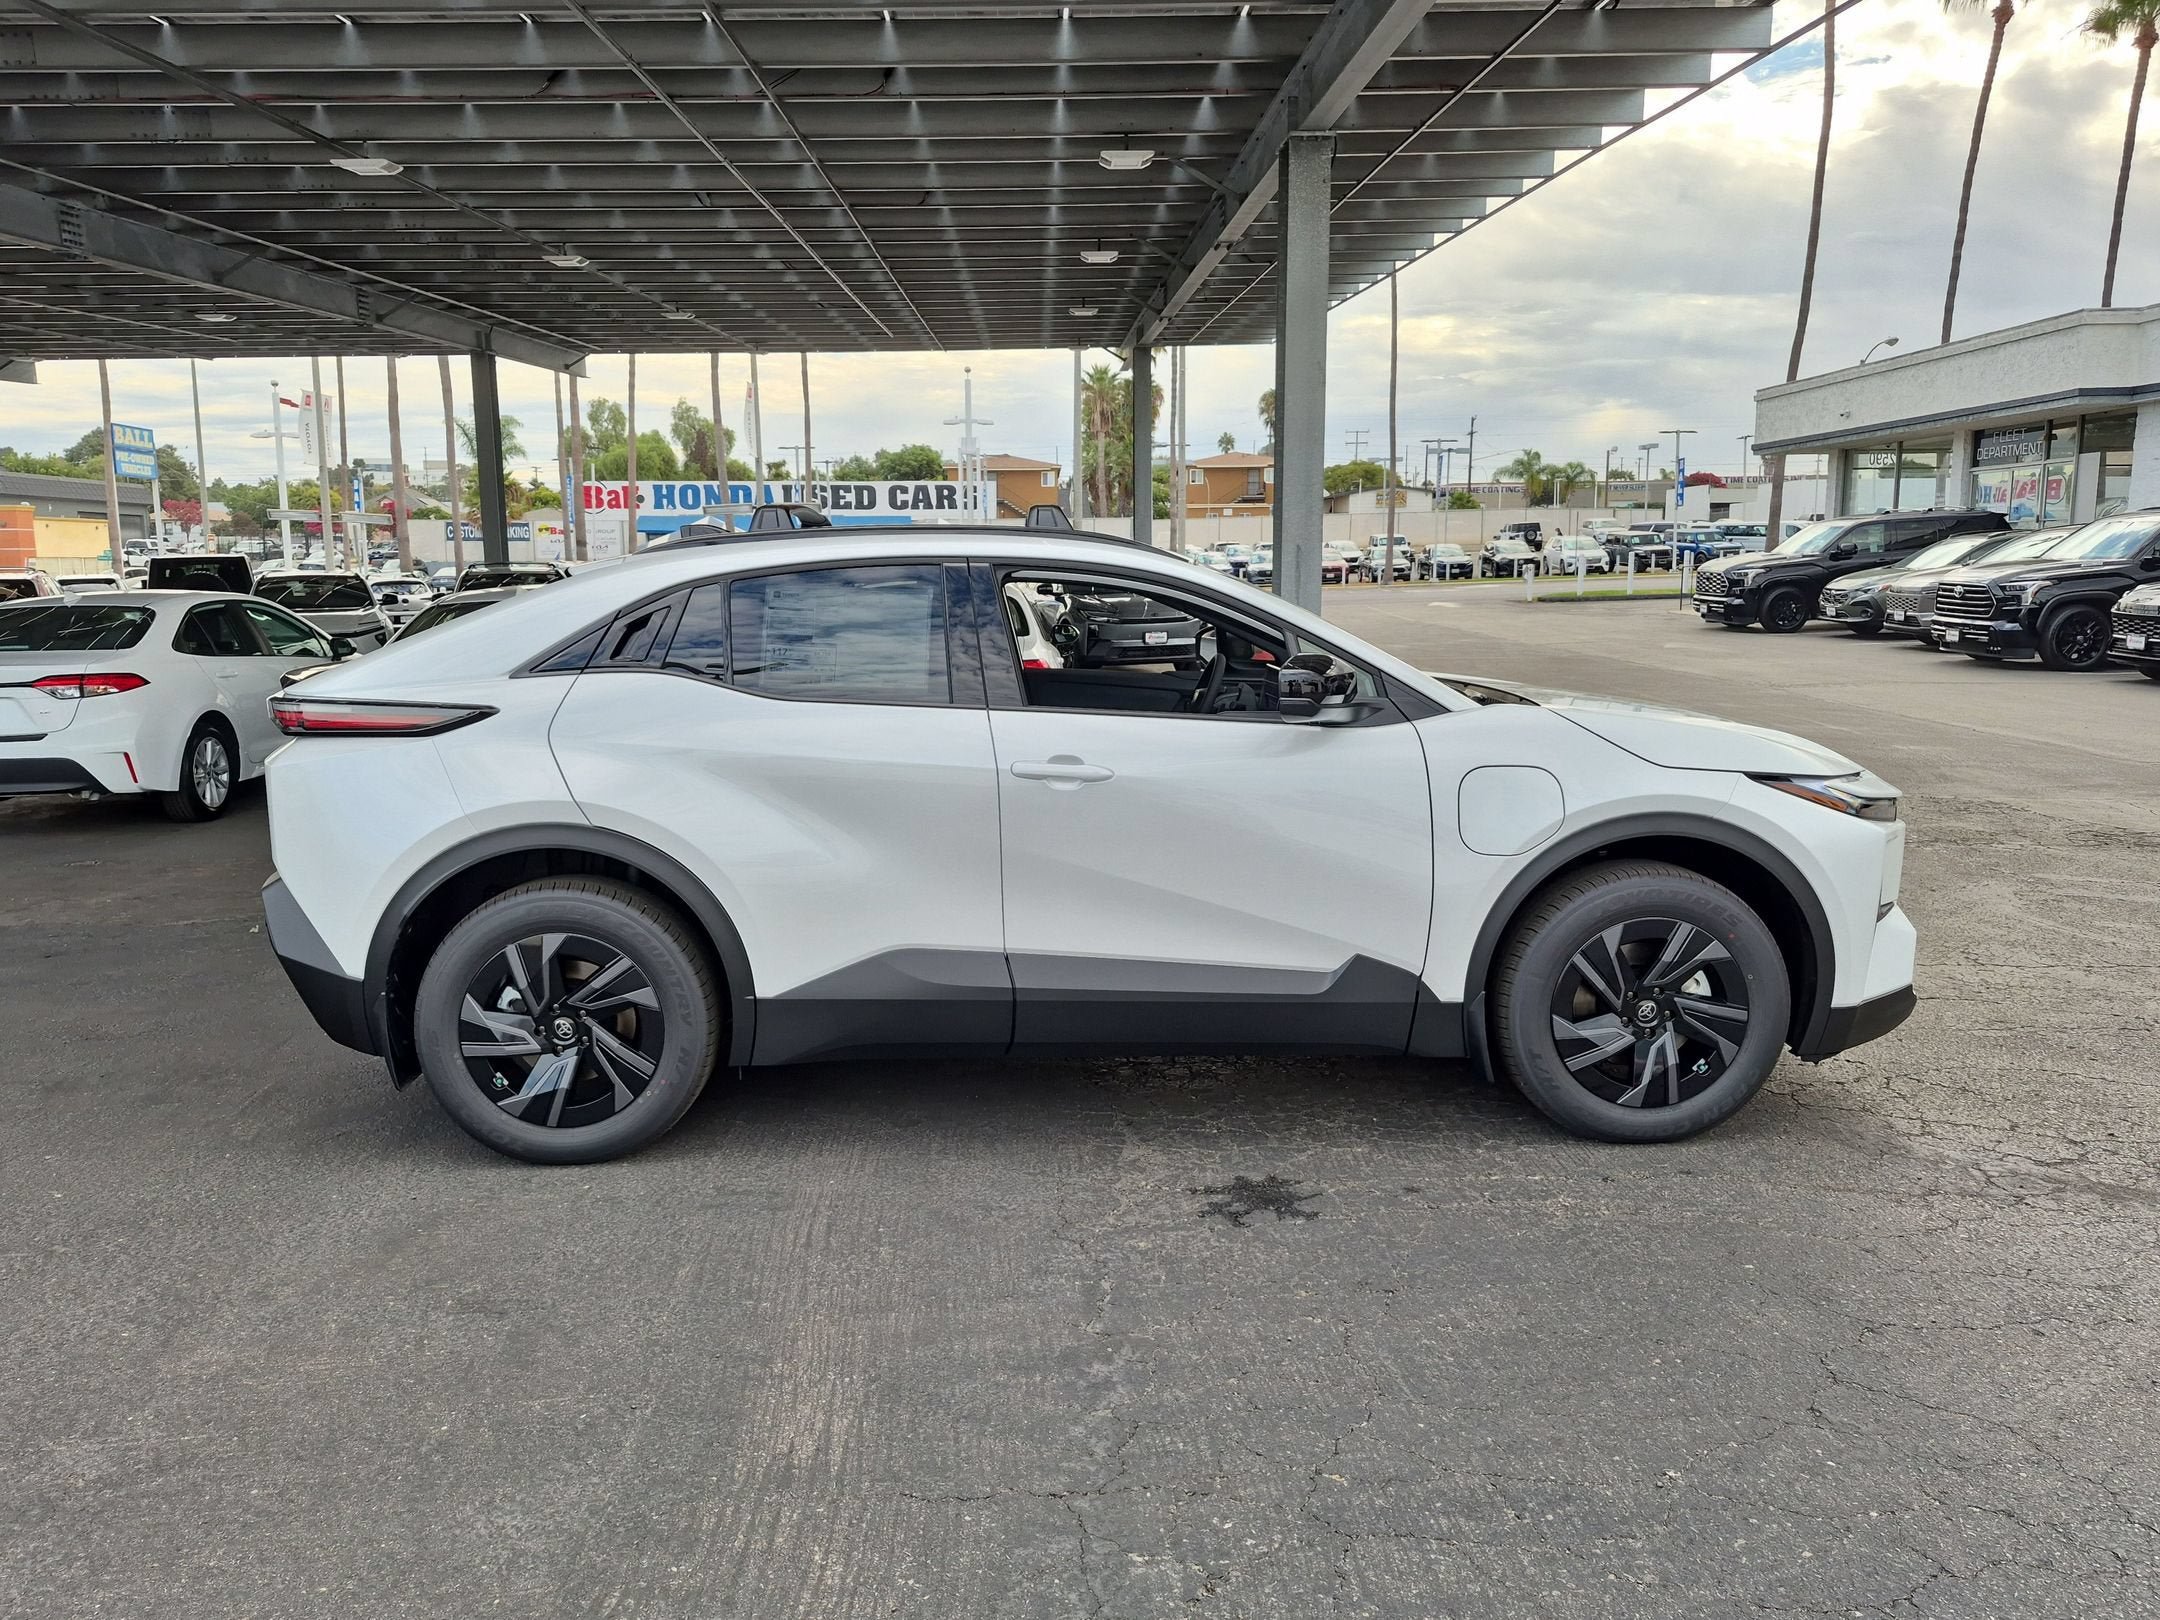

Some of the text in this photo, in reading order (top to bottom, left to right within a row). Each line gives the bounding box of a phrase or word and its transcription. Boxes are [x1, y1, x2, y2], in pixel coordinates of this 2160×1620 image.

[114, 427, 153, 448] BALL
[1993, 428, 2028, 443] FLEET
[1977, 441, 2043, 461] DEPARTMENT
[781, 484, 877, 511] USED
